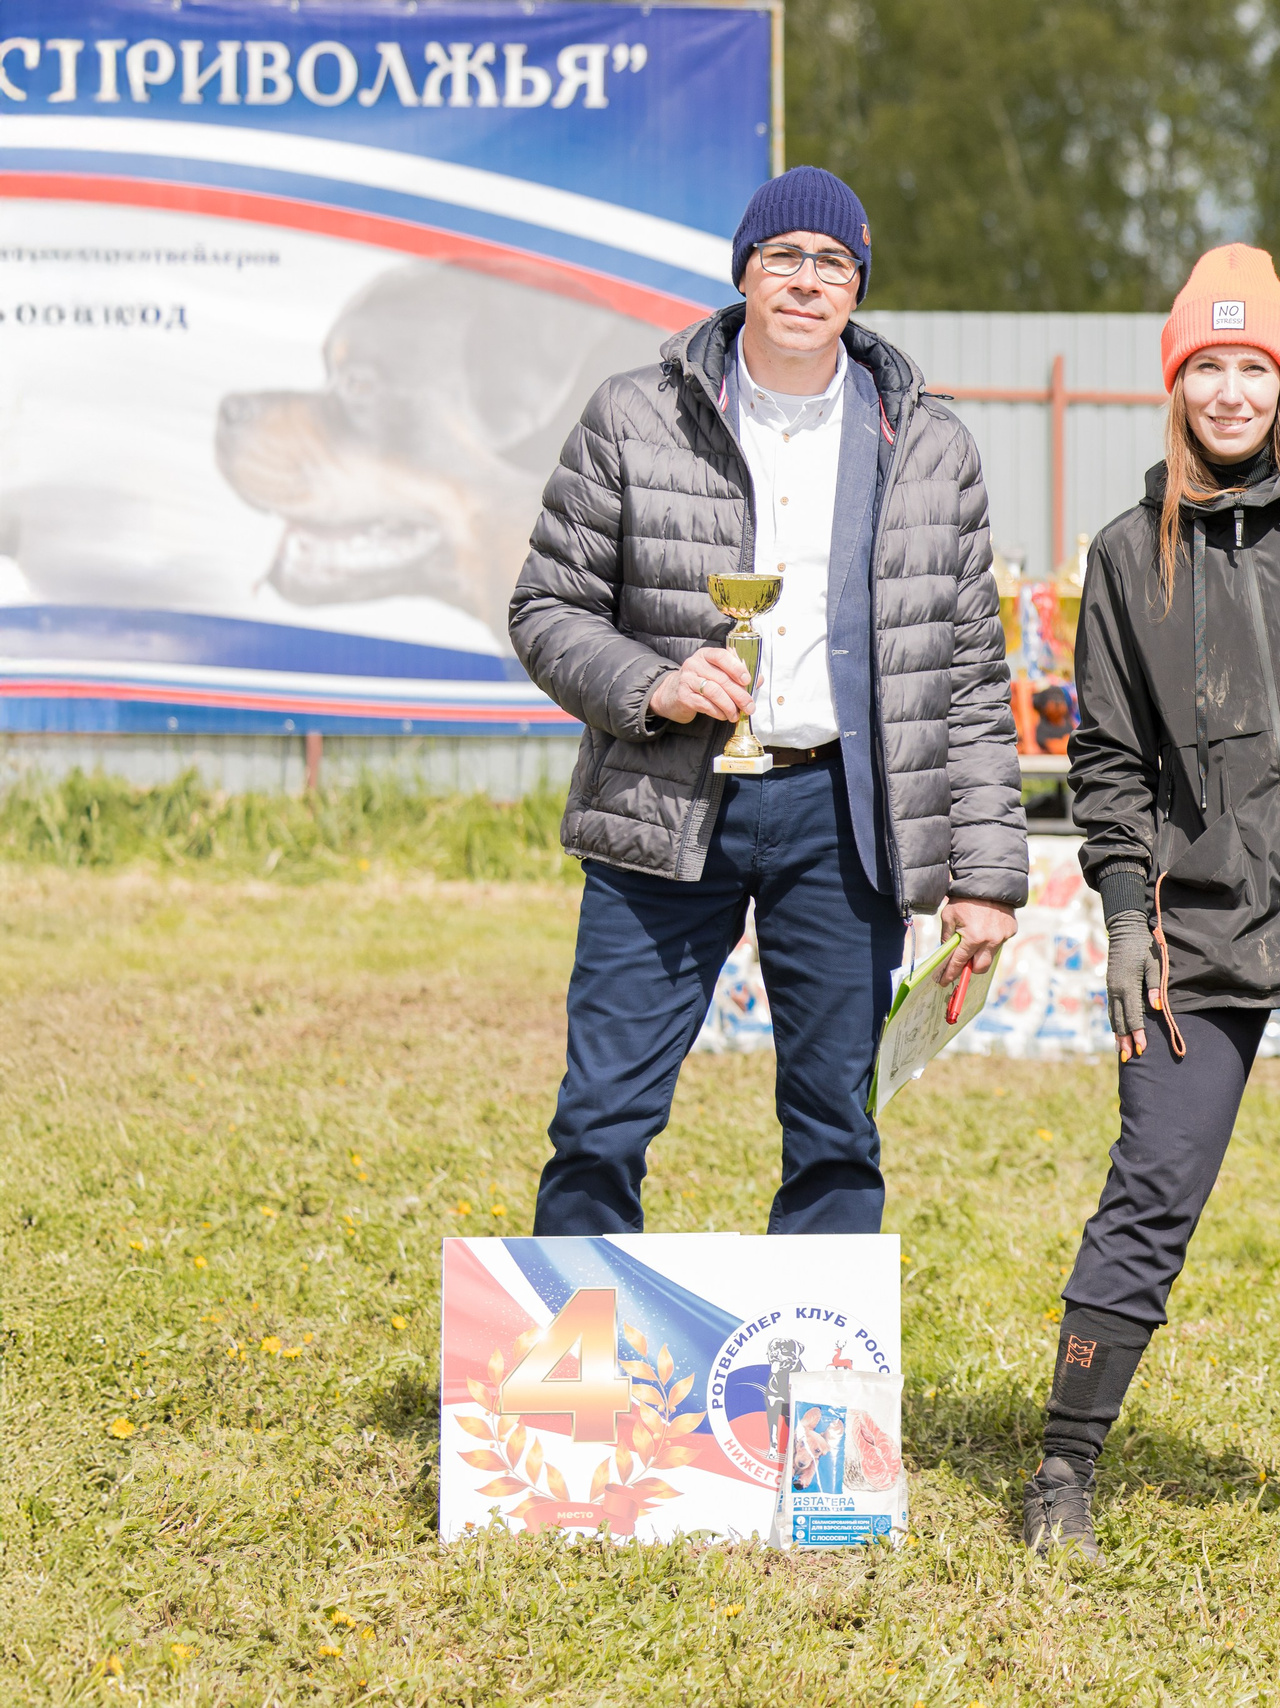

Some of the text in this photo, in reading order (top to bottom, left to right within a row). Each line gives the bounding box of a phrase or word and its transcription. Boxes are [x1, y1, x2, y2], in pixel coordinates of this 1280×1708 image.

[1219, 305, 1239, 316] NO
[500, 1287, 632, 1444] 4
[712, 1311, 782, 1410] РОТВЕЙЛЕР
[795, 1307, 848, 1328] КЛУБ
[557, 1511, 594, 1519] место
